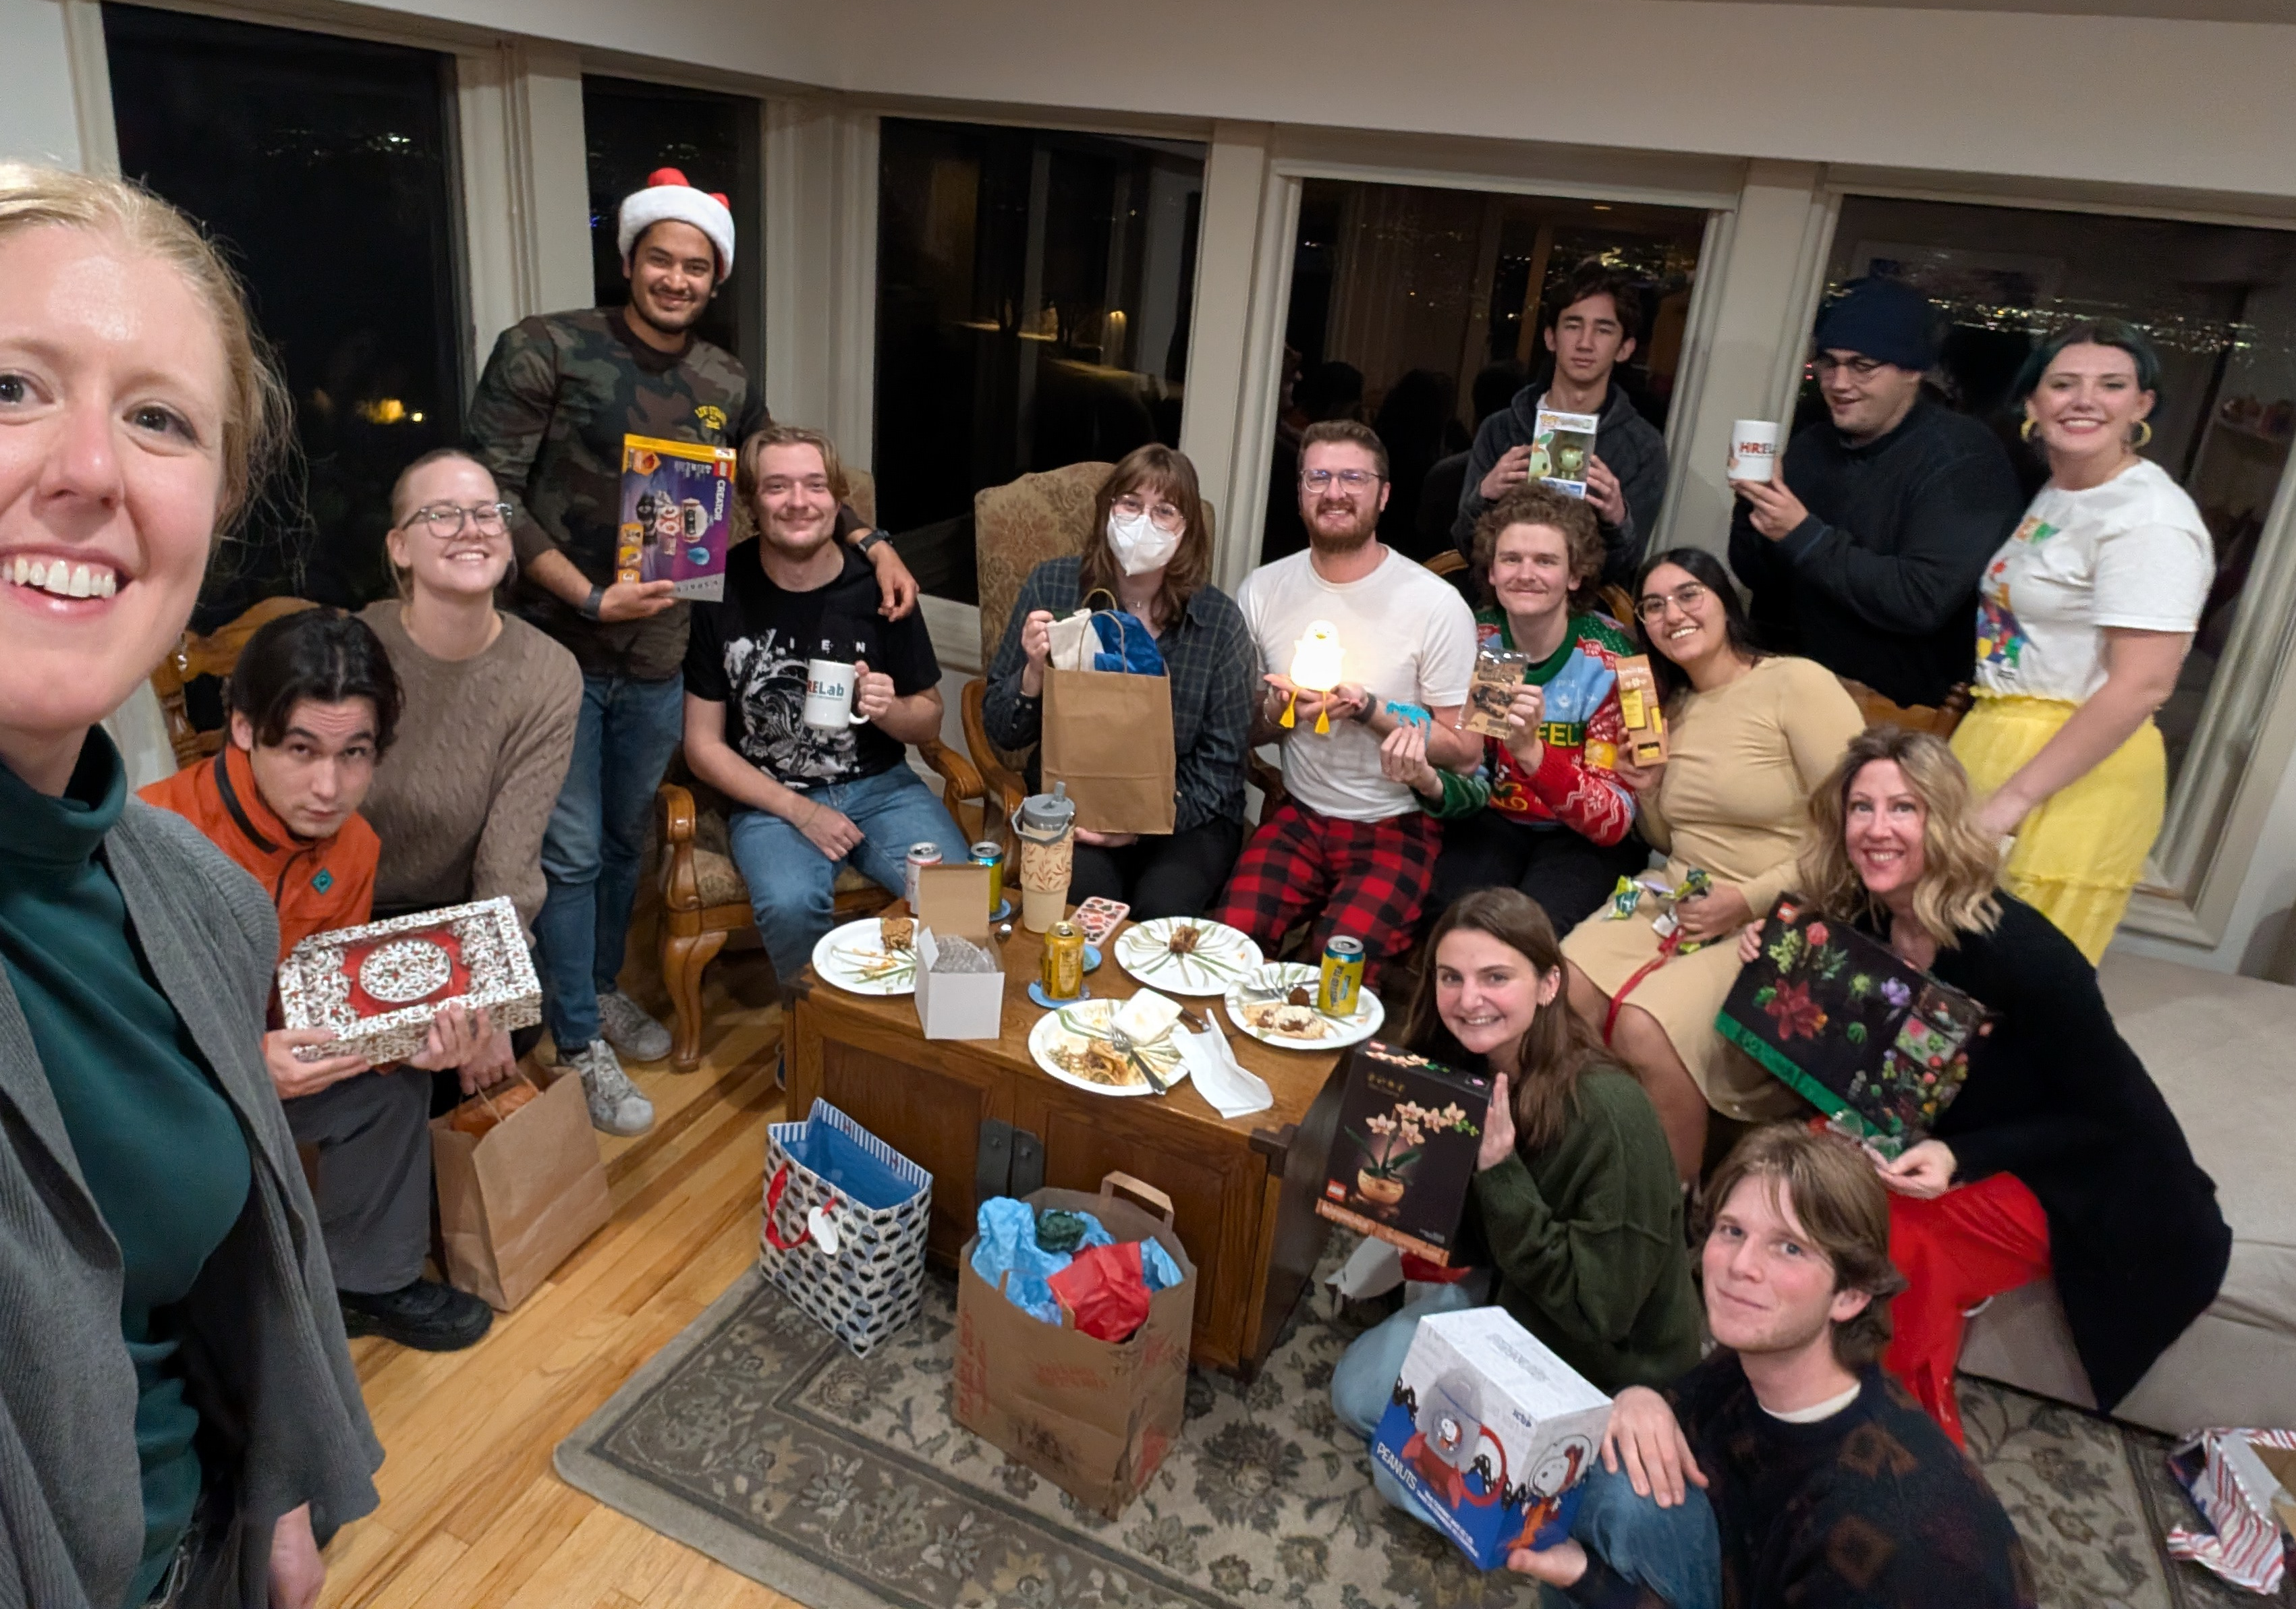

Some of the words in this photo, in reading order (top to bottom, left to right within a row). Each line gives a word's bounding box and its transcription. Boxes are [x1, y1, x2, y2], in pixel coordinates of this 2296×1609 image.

[715, 480, 726, 521] CREATOR
[756, 636, 866, 653] LIEN
[1376, 1442, 1417, 1488] PEANUTS
